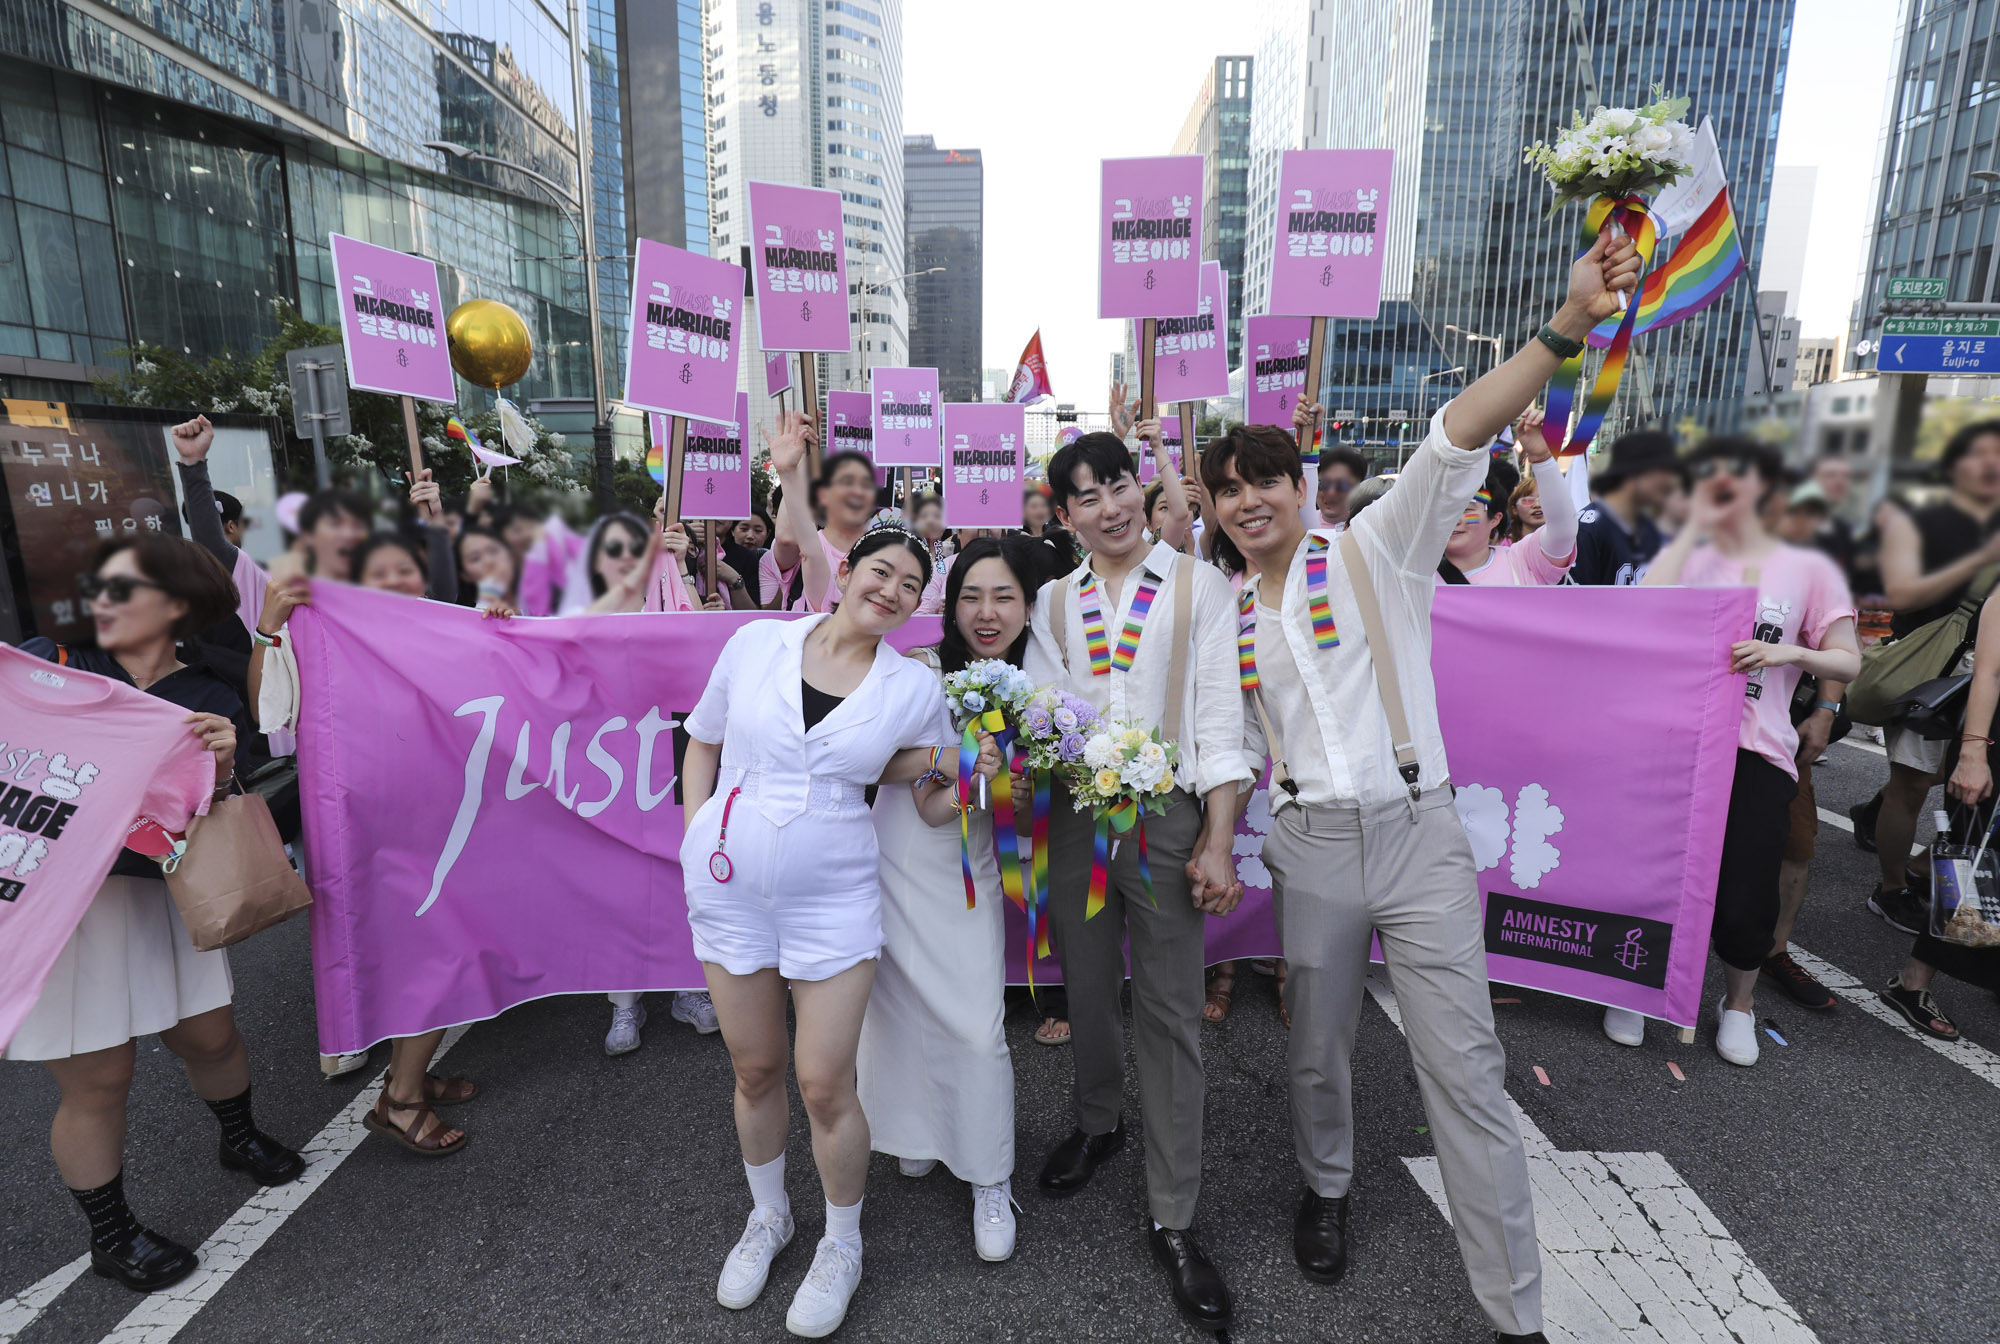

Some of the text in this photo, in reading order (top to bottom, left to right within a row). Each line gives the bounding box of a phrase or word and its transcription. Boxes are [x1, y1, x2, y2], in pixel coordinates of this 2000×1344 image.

[1113, 198, 1133, 219] 그
[1172, 195, 1192, 218] 냥
[1291, 189, 1313, 210] 그
[1356, 188, 1379, 212] 냥
[1112, 218, 1192, 241] MARRIAGE
[1288, 211, 1377, 233] MARRIAGE
[765, 224, 784, 245] 그
[817, 229, 835, 251] 냥
[1288, 232, 1374, 257] 결혼이야
[765, 247, 838, 273] MARRIAGE
[1112, 239, 1190, 263] 결혼이야
[353, 275, 374, 295] 그
[410, 288, 430, 310] 냥
[767, 268, 839, 295] 결혼이야
[1892, 281, 1944, 295] 을지로2가
[353, 293, 435, 329] MARRIAGE
[649, 281, 671, 304] 그
[712, 295, 733, 320] 냥
[357, 313, 437, 348] 결혼이야
[646, 302, 731, 341] MARRIAGE
[1157, 314, 1215, 337] ARRIAGE
[1897, 322, 1939, 333] 을지로1가
[1954, 322, 1988, 333] 청계2가
[646, 323, 729, 363] 결혼이야
[1256, 345, 1271, 360] 그
[1942, 340, 1985, 356] 을지로
[1256, 354, 1308, 376] MARRIAG
[1942, 357, 1980, 368] Eulji-ro
[882, 391, 894, 402] 그
[918, 390, 931, 403] 냥
[834, 412, 847, 425] 그
[881, 403, 932, 416] MARRIAGE
[834, 425, 872, 440] MARRIA
[882, 416, 933, 430] 결혼이야
[685, 436, 741, 455] ARRIAGE
[954, 434, 970, 449] 그
[1000, 433, 1016, 450] 냥
[22, 442, 100, 467] 누구나
[953, 449, 1016, 466] MARRIAGE
[953, 466, 1016, 484] 결혼이야
[29, 480, 108, 507] 언니가
[40, 752, 100, 800] 냥
[414, 695, 681, 917] Just
[1502, 909, 1598, 942] AMNESTY
[1501, 929, 1594, 958] INTERNATIONAL
